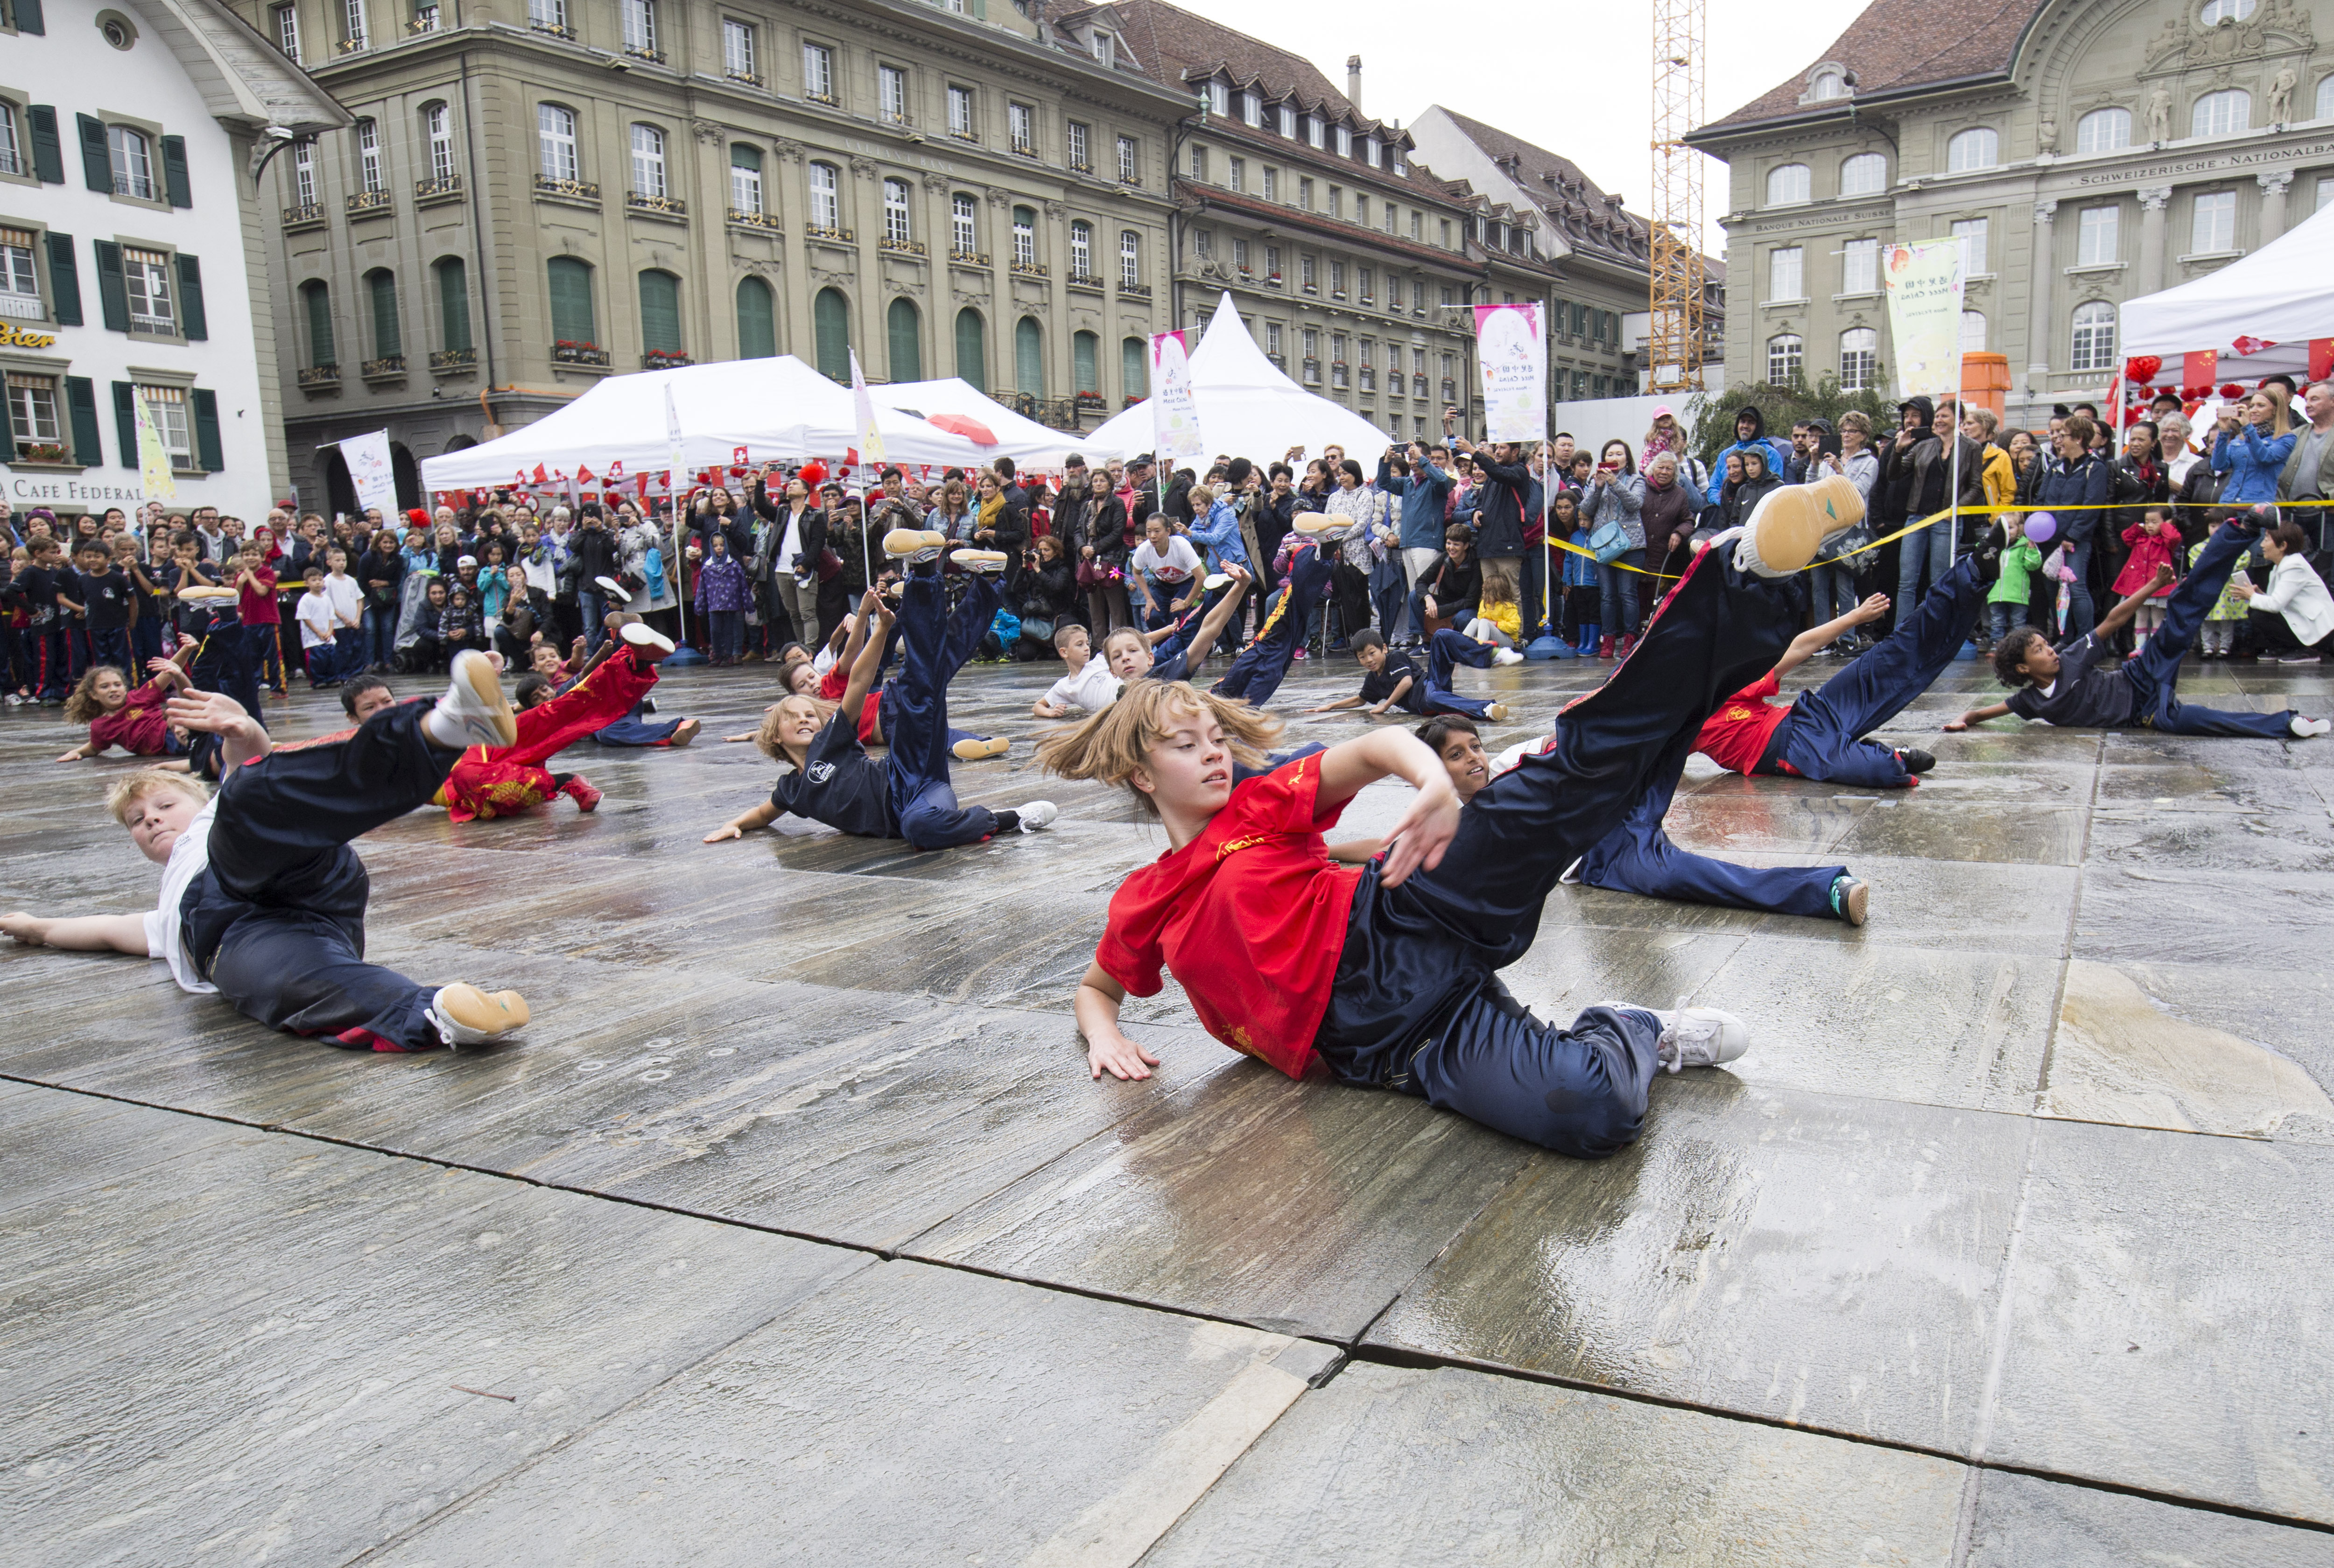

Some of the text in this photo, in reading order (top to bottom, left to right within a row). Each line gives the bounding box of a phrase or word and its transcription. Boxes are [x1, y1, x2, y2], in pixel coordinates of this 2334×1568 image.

[2081, 160, 2216, 185] SCHWEIZERISCHE
[1756, 210, 1891, 232] BANQUE NATIONALE SUISSE
[14, 479, 60, 498] CAFÉ
